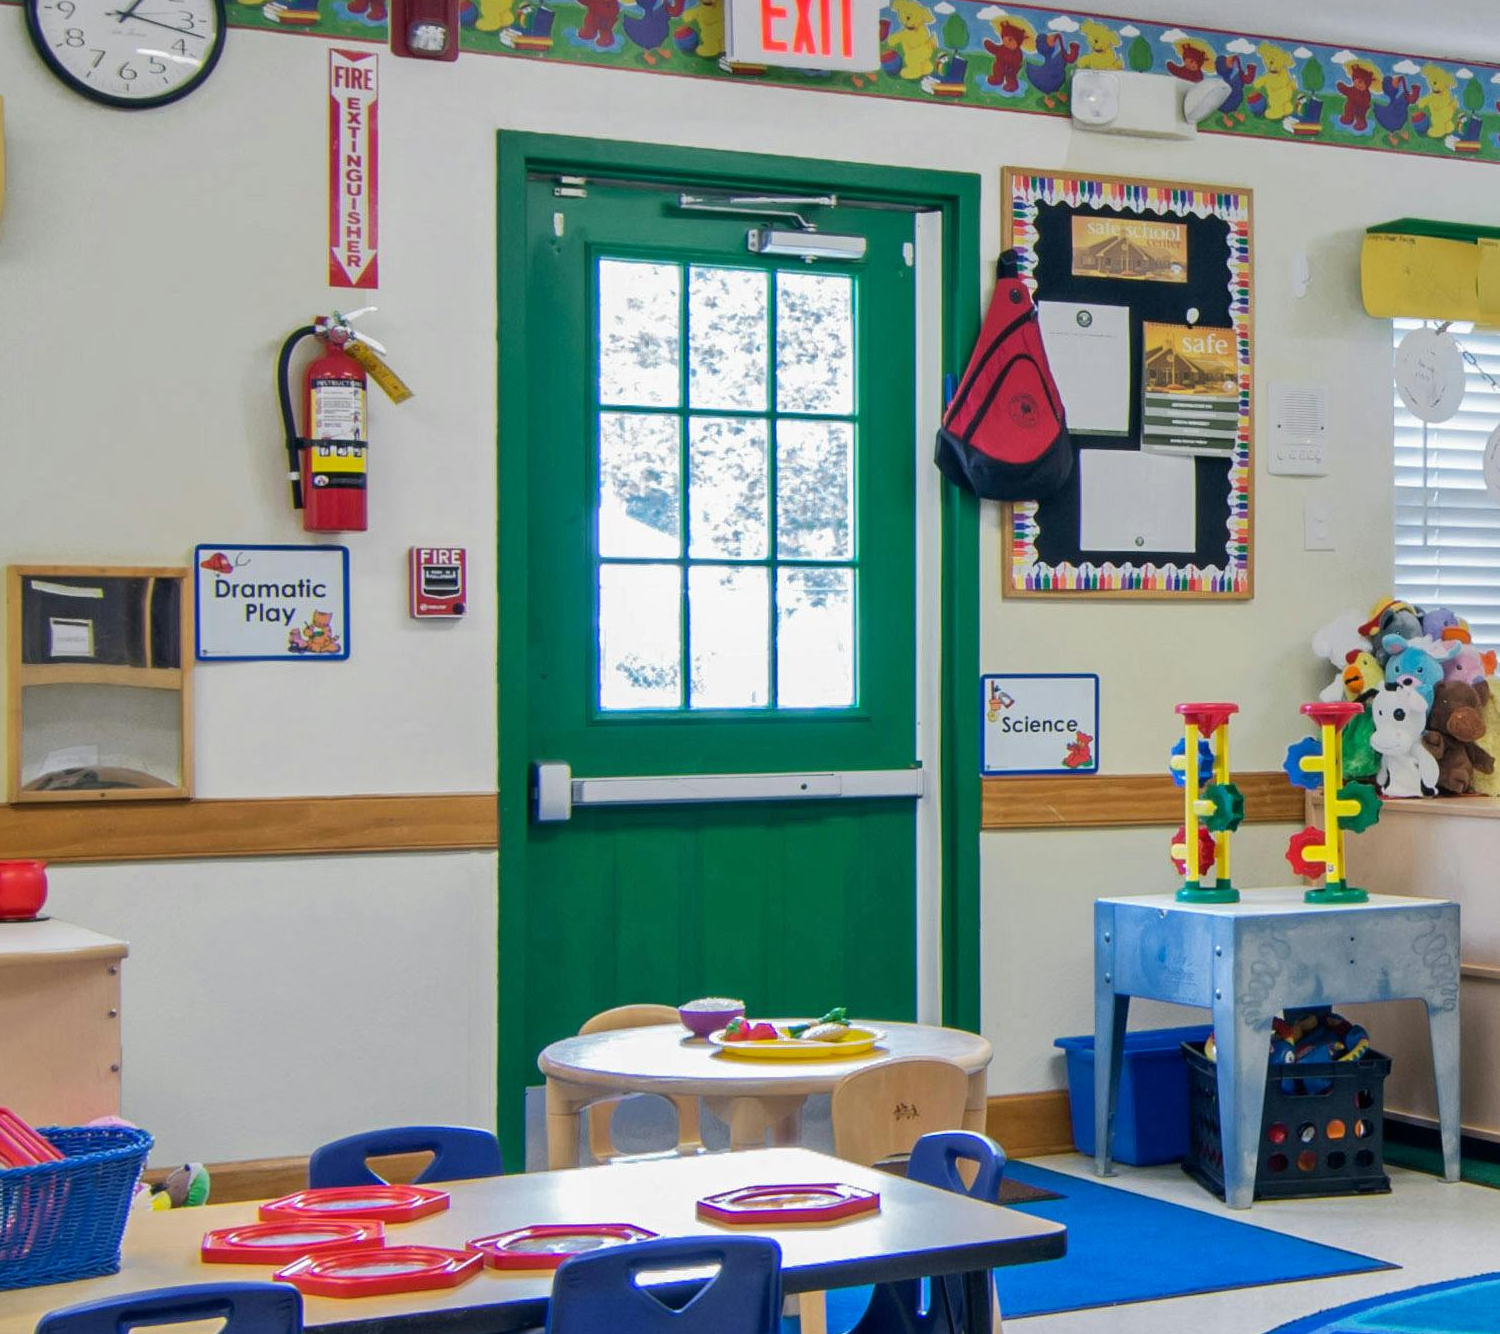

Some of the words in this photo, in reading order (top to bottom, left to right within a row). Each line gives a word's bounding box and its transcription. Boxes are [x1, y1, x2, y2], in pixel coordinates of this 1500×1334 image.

[57, 0, 76, 20] 9
[177, 10, 195, 30] 3
[66, 27, 86, 48] 8
[171, 38, 187, 56] 4
[90, 49, 106, 68] 7
[149, 55, 167, 74] 5
[119, 61, 138, 81] 6
[334, 65, 374, 91] FIRE
[346, 97, 363, 268] EXTINGUISHER
[1087, 219, 1120, 236] safe
[1125, 223, 1180, 241] school
[1182, 333, 1229, 355] safe
[421, 550, 461, 564] FIRE
[215, 579, 327, 598] Dramatic
[245, 603, 297, 626] Play
[1002, 715, 1078, 733] Science
